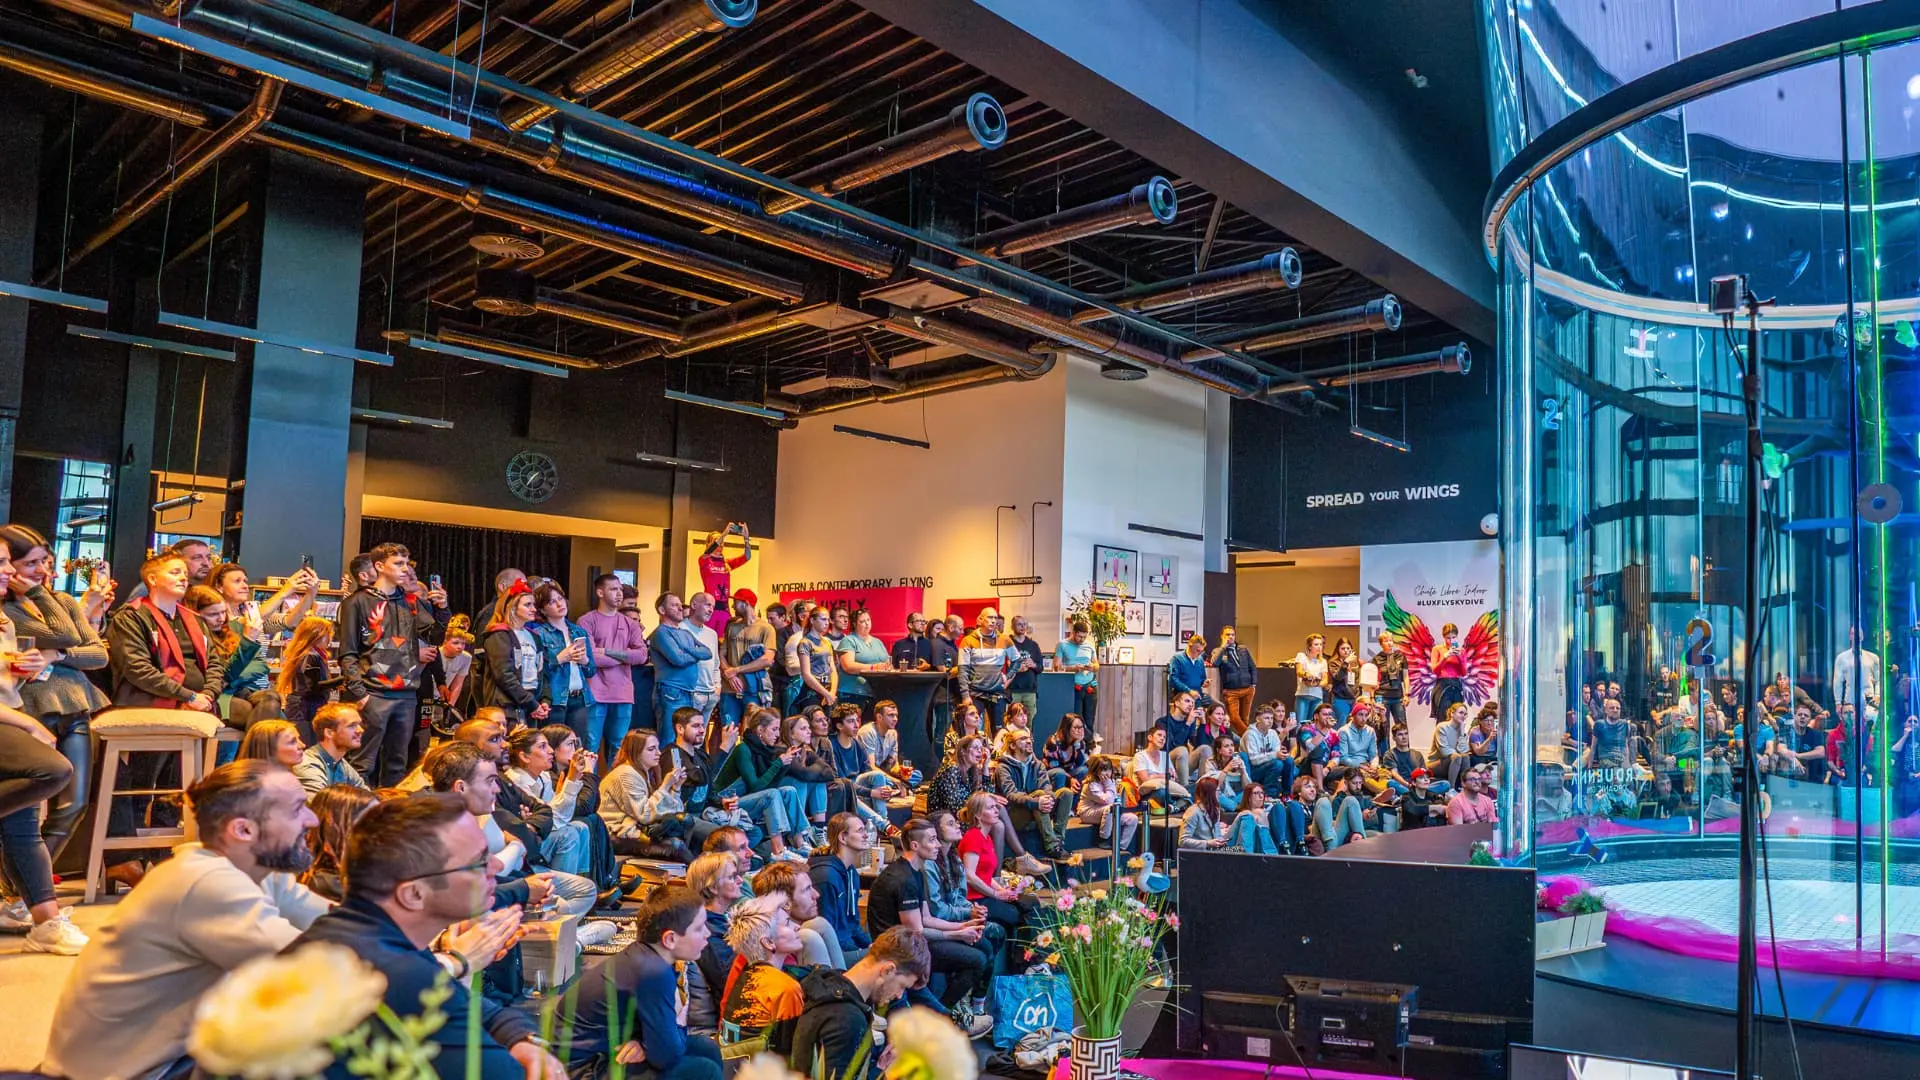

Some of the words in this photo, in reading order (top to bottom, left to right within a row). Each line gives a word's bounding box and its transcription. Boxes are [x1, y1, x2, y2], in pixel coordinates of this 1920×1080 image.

[1306, 491, 1364, 508] SPREAD
[1369, 490, 1400, 502] YOUR
[1405, 484, 1460, 500] WINGS
[771, 582, 807, 594] MODERN
[816, 578, 893, 591] CONTEMPORARY
